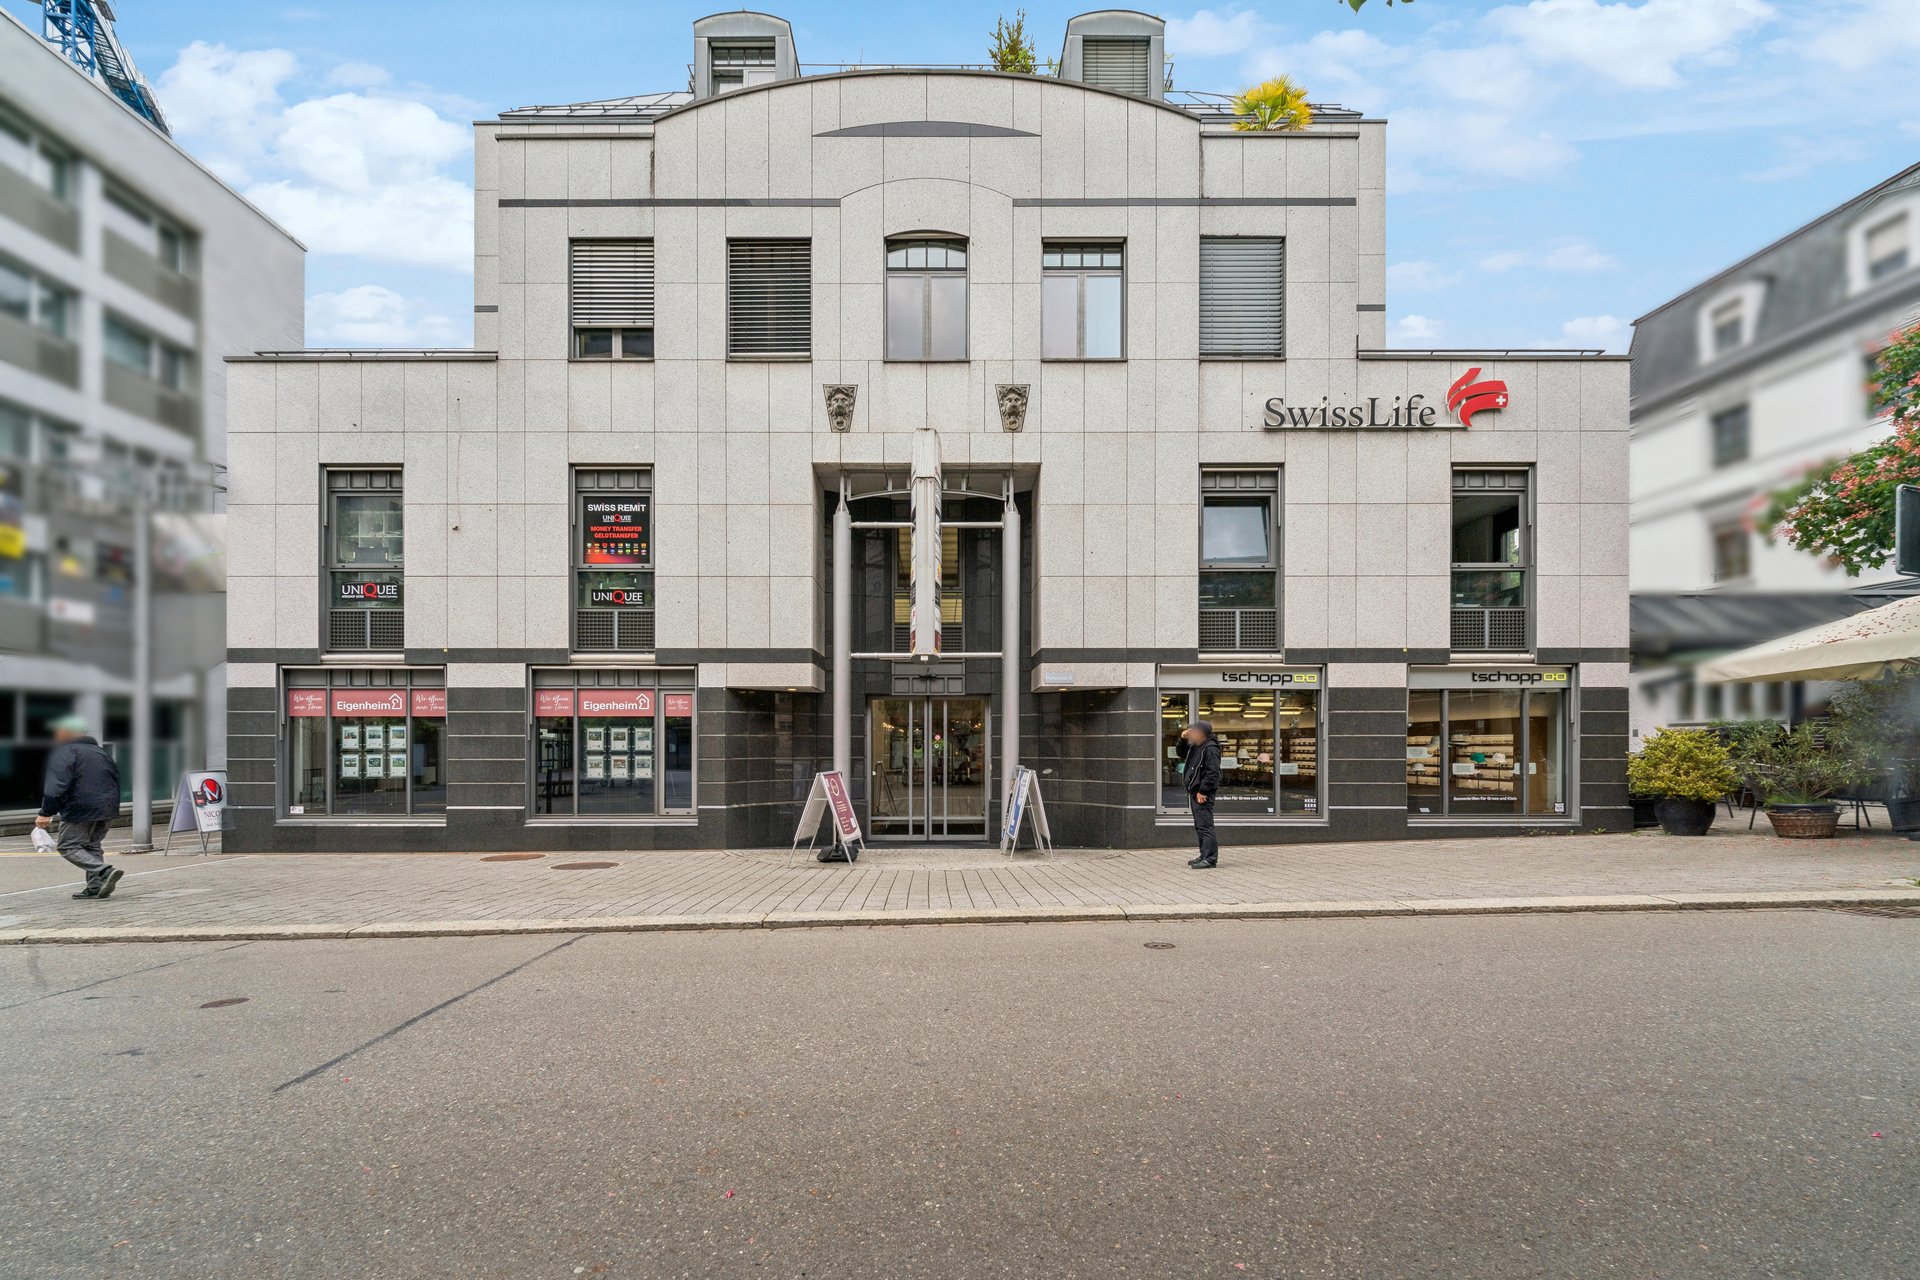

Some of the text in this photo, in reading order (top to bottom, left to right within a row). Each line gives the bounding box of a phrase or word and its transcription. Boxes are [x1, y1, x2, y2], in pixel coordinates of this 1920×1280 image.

[341, 583, 398, 598] UNIQUEE
[592, 590, 643, 604] UNIQUEE
[336, 701, 390, 711] Eigenheim
[583, 701, 637, 711] Eigenheim
